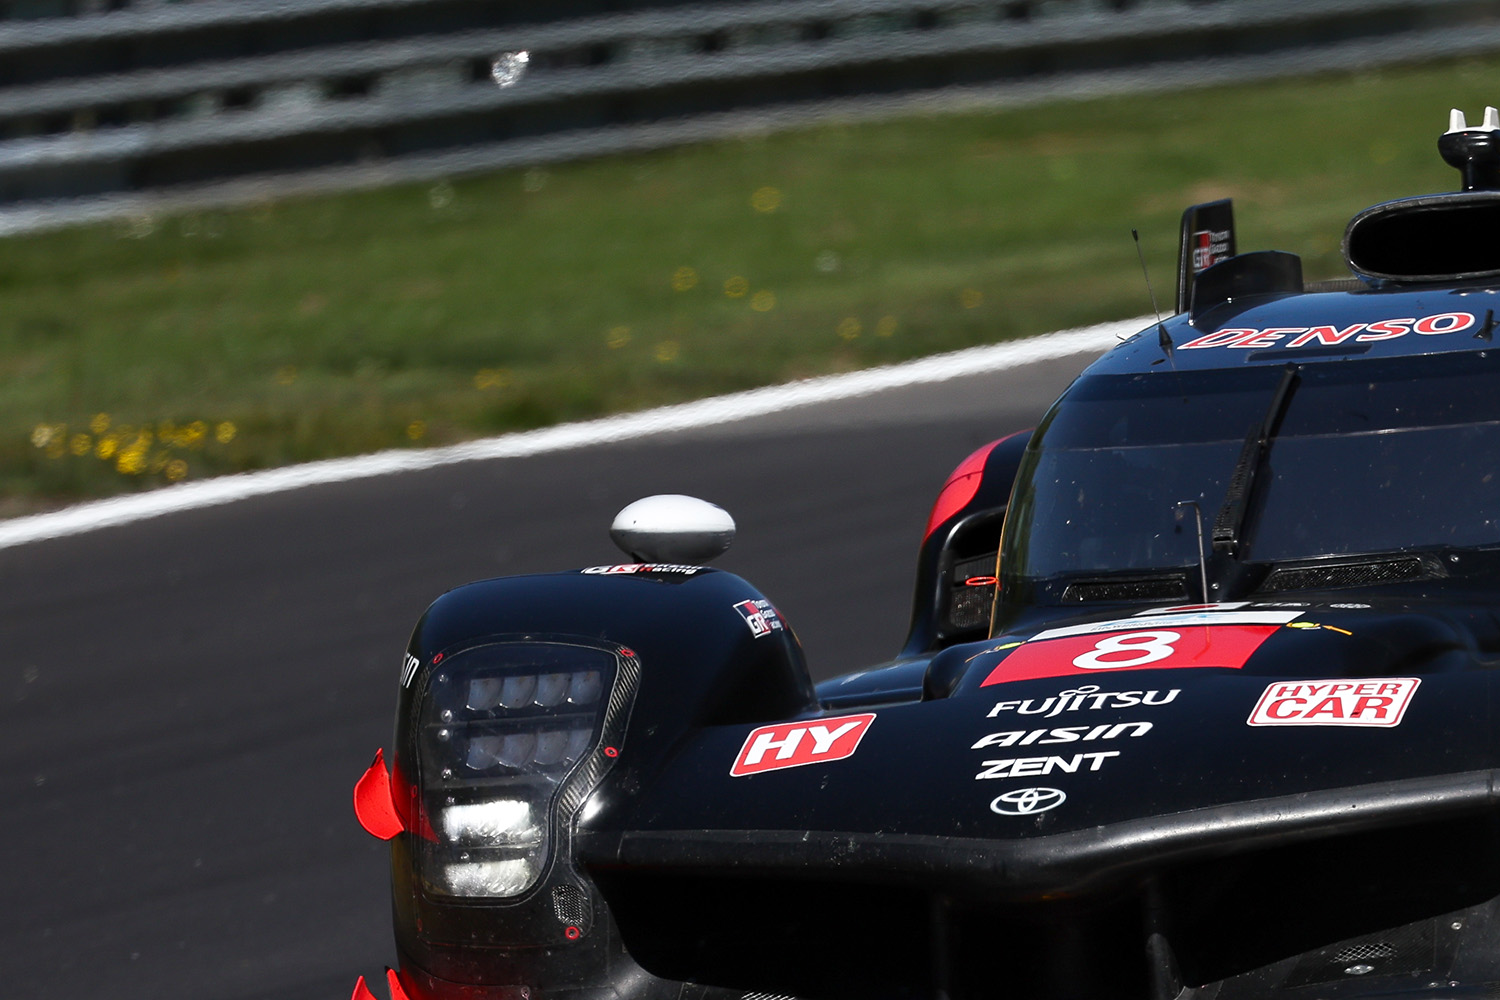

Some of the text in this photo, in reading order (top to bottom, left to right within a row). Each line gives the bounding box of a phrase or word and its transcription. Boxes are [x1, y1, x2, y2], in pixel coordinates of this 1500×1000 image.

[1177, 312, 1476, 350] DENSO
[747, 612, 769, 634] GR
[1072, 631, 1181, 669] 8
[986, 685, 1182, 718] FUJITSU
[1276, 683, 1403, 697] HYPER
[1267, 696, 1393, 720] CAR
[745, 721, 862, 766] HY
[970, 721, 1154, 749] AISIN
[975, 750, 1120, 780] ZENT
